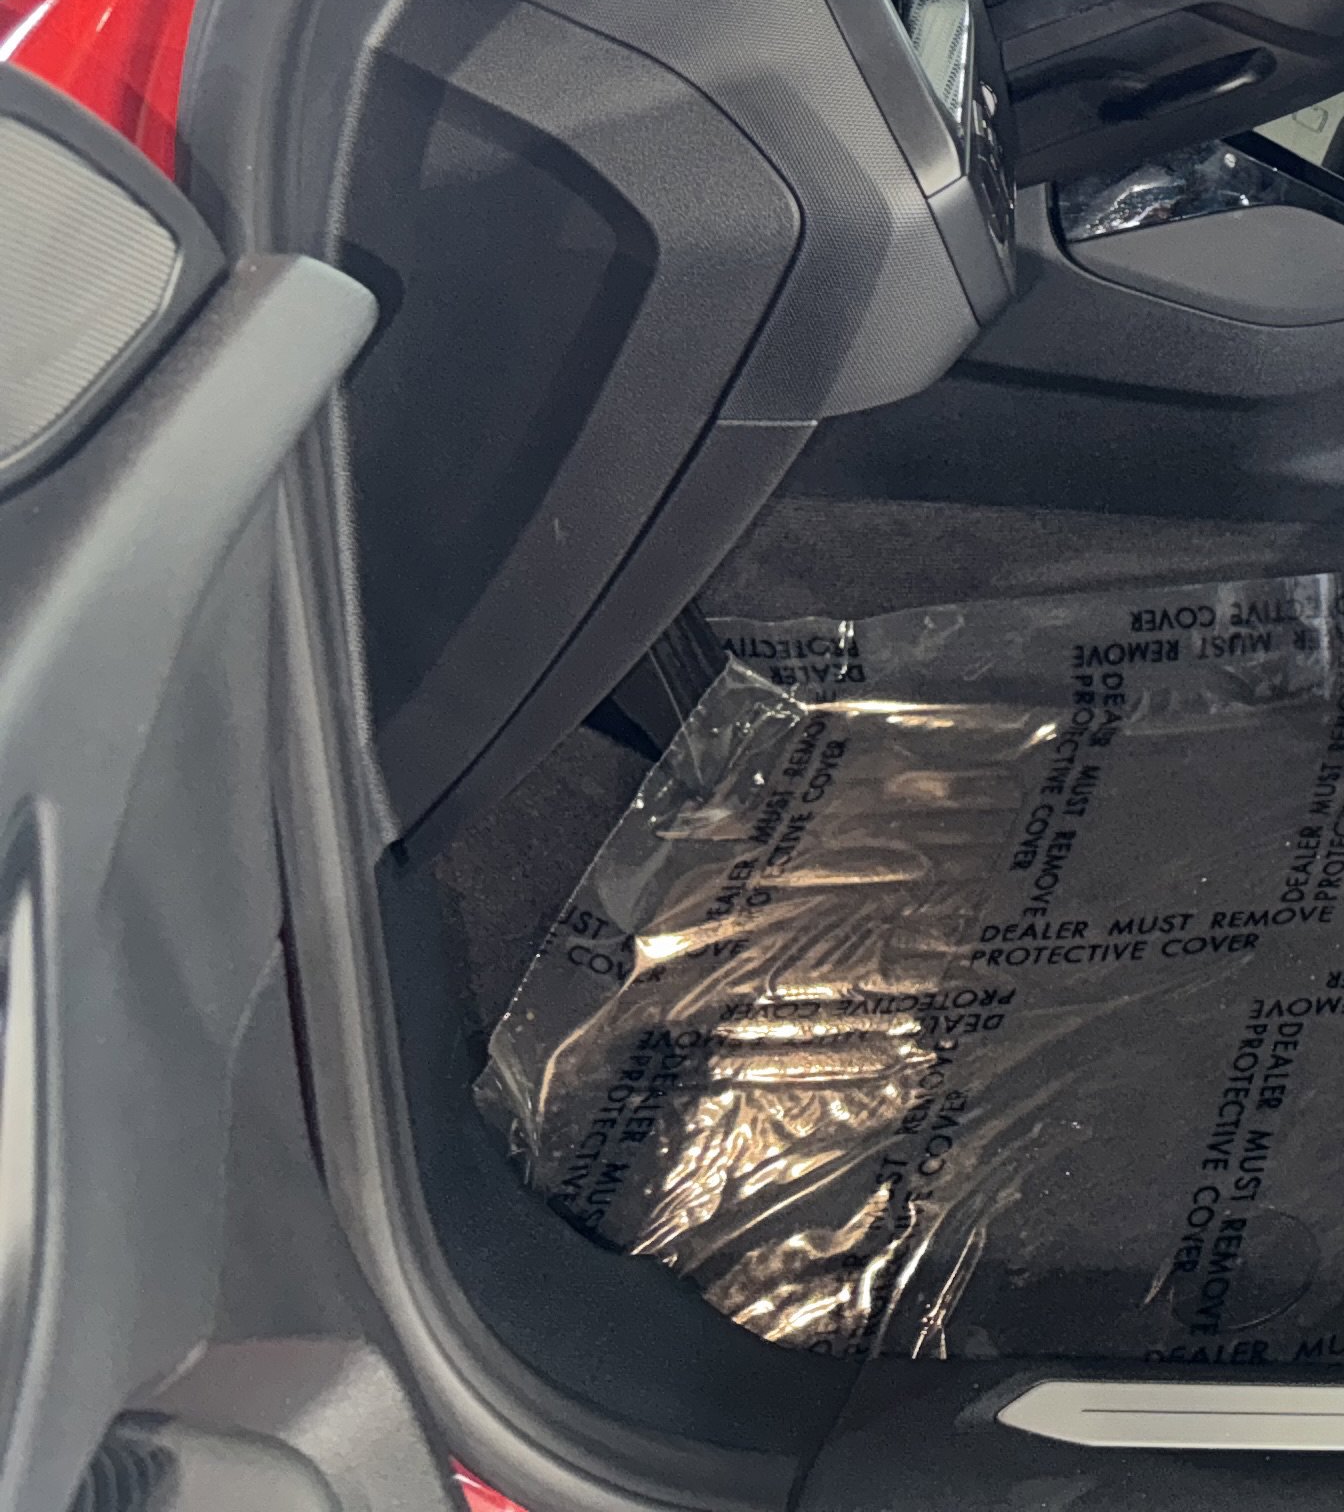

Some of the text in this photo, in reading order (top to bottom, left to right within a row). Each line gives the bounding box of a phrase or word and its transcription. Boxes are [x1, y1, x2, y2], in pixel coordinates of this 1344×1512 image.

[1130, 605, 1216, 632] COVER
[1197, 631, 1272, 660] MUST
[1072, 639, 1180, 669] REMOVE
[802, 738, 848, 804] COVER
[1062, 765, 1102, 817] MUST
[1008, 803, 1054, 872] COVER
[1279, 825, 1323, 903] DEALER
[1308, 762, 1343, 816] MUST
[1021, 830, 1077, 918] REMOVE
[970, 933, 1260, 968] PROTECTIVE COVER
[980, 906, 1336, 943] DEALER MUST REMOVE
[719, 986, 1018, 1022] PROTECTIVE COVER
[918, 1089, 971, 1176] COVER
[1173, 1023, 1268, 1272] PROTECTIVE COVER
[1190, 1021, 1304, 1336] DEALER MUST REMOVE
